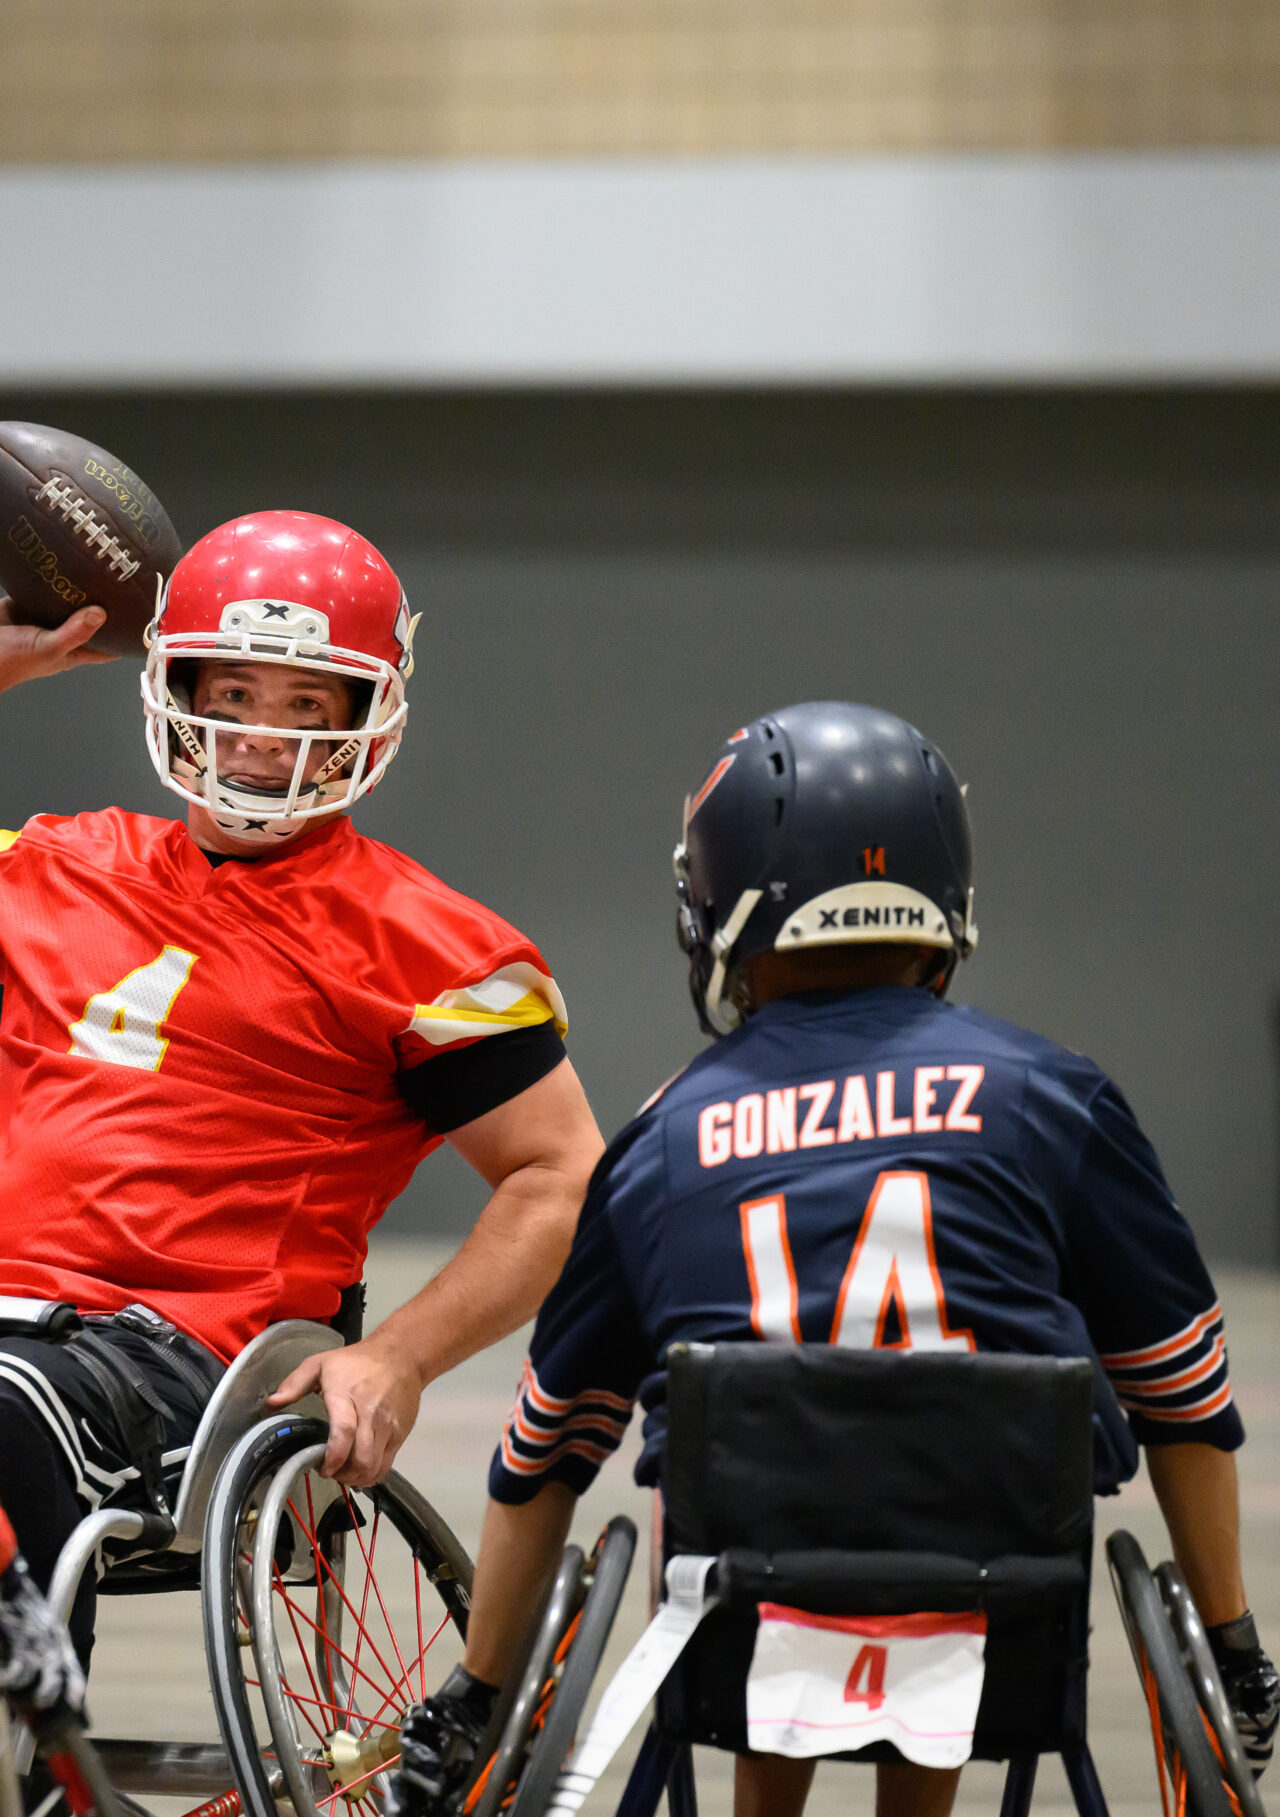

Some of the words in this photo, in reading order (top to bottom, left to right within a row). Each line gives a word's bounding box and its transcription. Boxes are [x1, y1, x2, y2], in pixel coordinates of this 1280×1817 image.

[9, 515, 87, 605] Wilson
[862, 847, 886, 876] 14
[818, 907, 925, 929] XENITH
[67, 944, 200, 1073] 4
[698, 1064, 985, 1168] GONZALEZ
[739, 1170, 978, 1353] 14
[843, 1643, 889, 1711] 4
